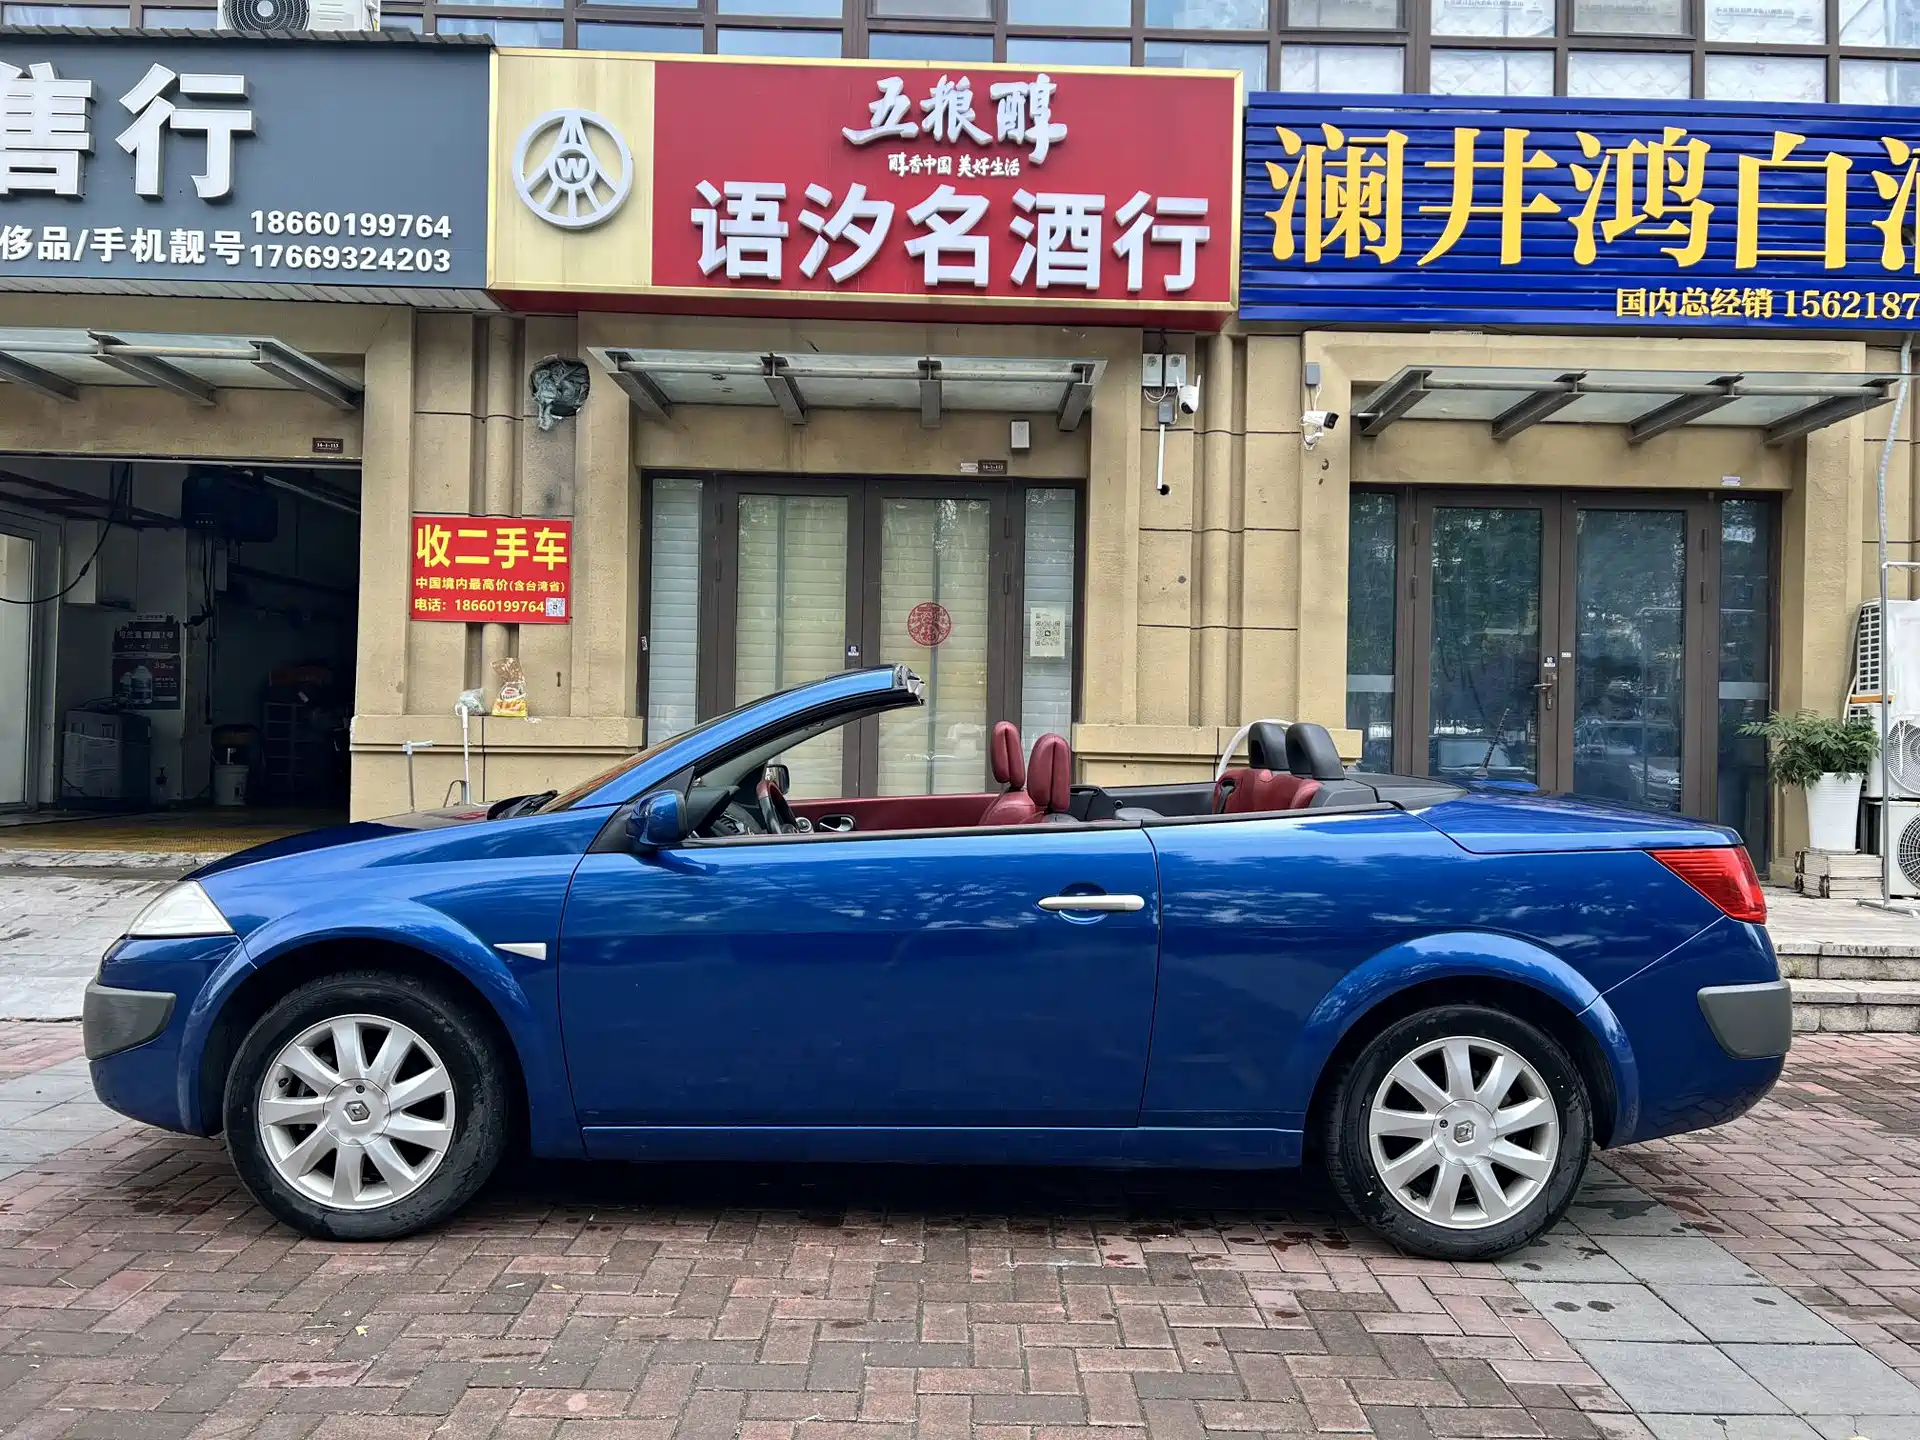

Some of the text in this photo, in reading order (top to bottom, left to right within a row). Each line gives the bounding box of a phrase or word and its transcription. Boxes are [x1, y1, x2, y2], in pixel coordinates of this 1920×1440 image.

[842, 73, 1068, 164] 五粮醇
[888, 152, 1020, 178] 醇香中国 美好生活
[250, 209, 452, 238] 18660199764
[691, 180, 1210, 292] 语汐名酒行
[250, 244, 450, 272] 17669324203
[1616, 287, 1773, 318] 国内总经销
[416, 524, 568, 571] 收二手车
[415, 576, 565, 593] 中国境内最高价(含台湾省)
[454, 599, 545, 613] 18660199764
